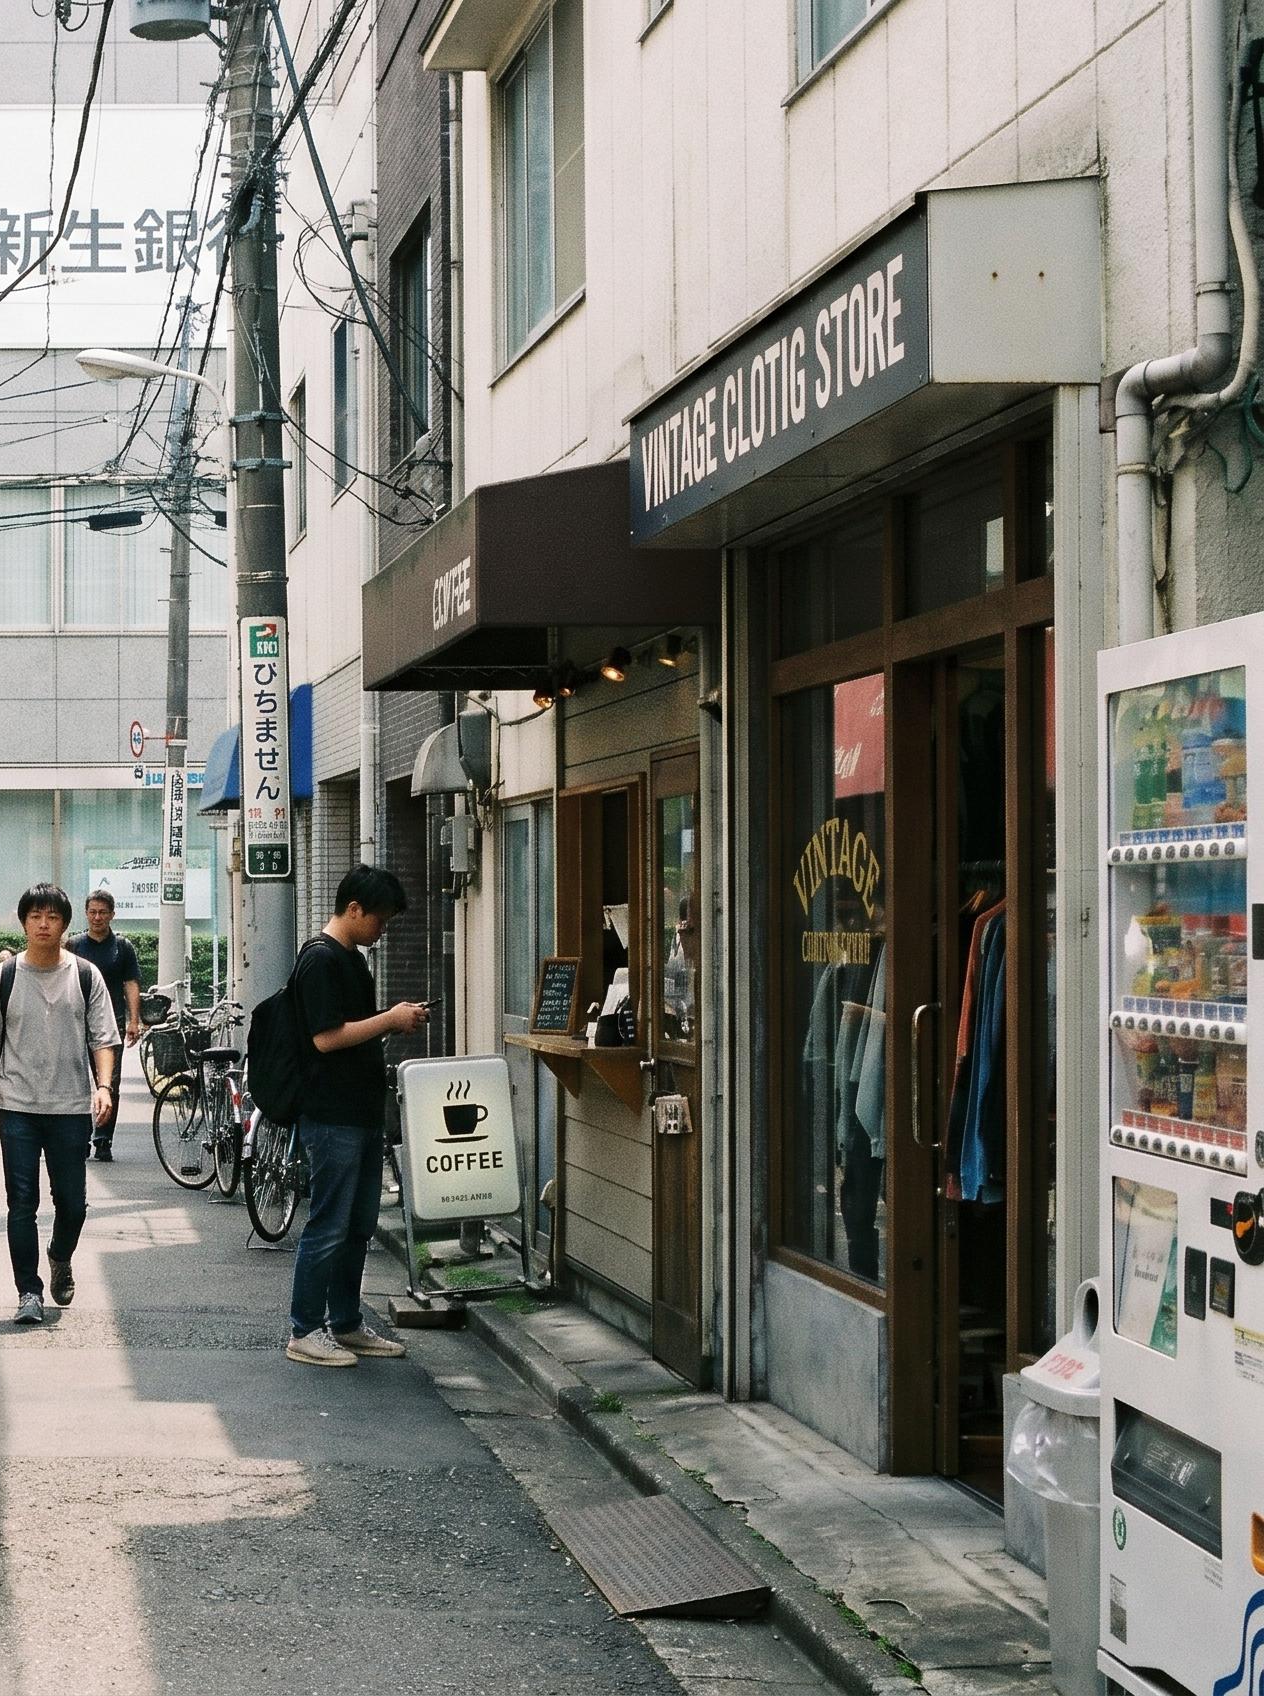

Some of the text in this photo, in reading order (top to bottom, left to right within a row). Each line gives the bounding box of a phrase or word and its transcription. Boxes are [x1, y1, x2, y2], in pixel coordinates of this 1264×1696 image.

[641, 253, 905, 512] VINTAGE CLOTIG STORE
[253, 661, 280, 801] びちません
[426, 1151, 504, 1174] COFFEE
